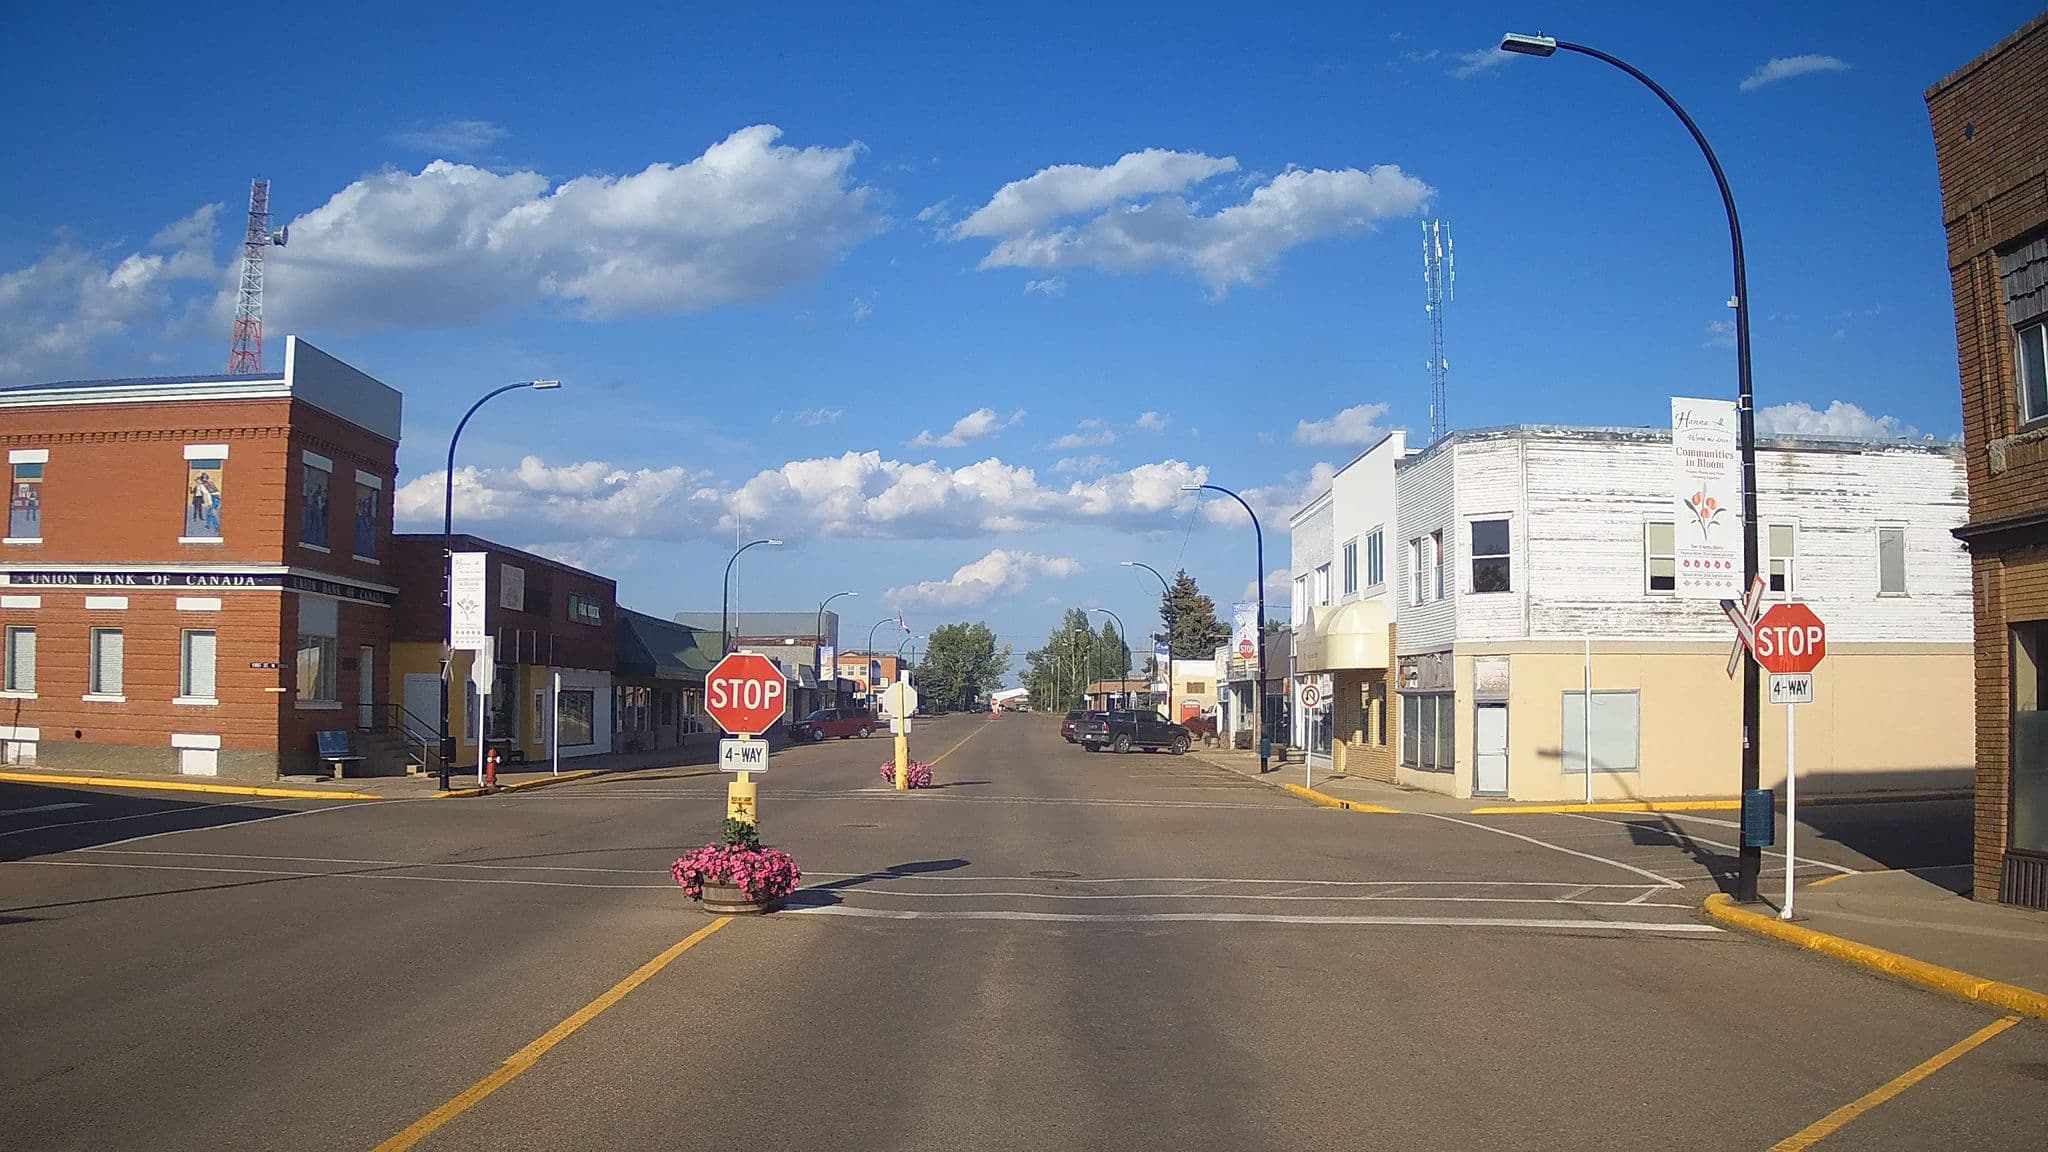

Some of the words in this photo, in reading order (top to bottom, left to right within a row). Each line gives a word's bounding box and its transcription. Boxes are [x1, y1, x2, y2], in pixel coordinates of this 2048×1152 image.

[1674, 409, 1709, 430] Hanna
[1675, 446, 1735, 460] Communities
[1685, 457, 1695, 467] in
[1697, 458, 1725, 469] Bloom
[30, 574, 78, 585] UNION
[93, 575, 136, 586] BANK
[151, 575, 171, 586] OF
[186, 576, 256, 587] CANADA
[1240, 645, 1254, 655] STOP
[1758, 626, 1823, 657] STOP
[710, 678, 782, 710] STOP
[1773, 679, 1808, 696] 4-WAY
[725, 747, 763, 764] 4-WAY
